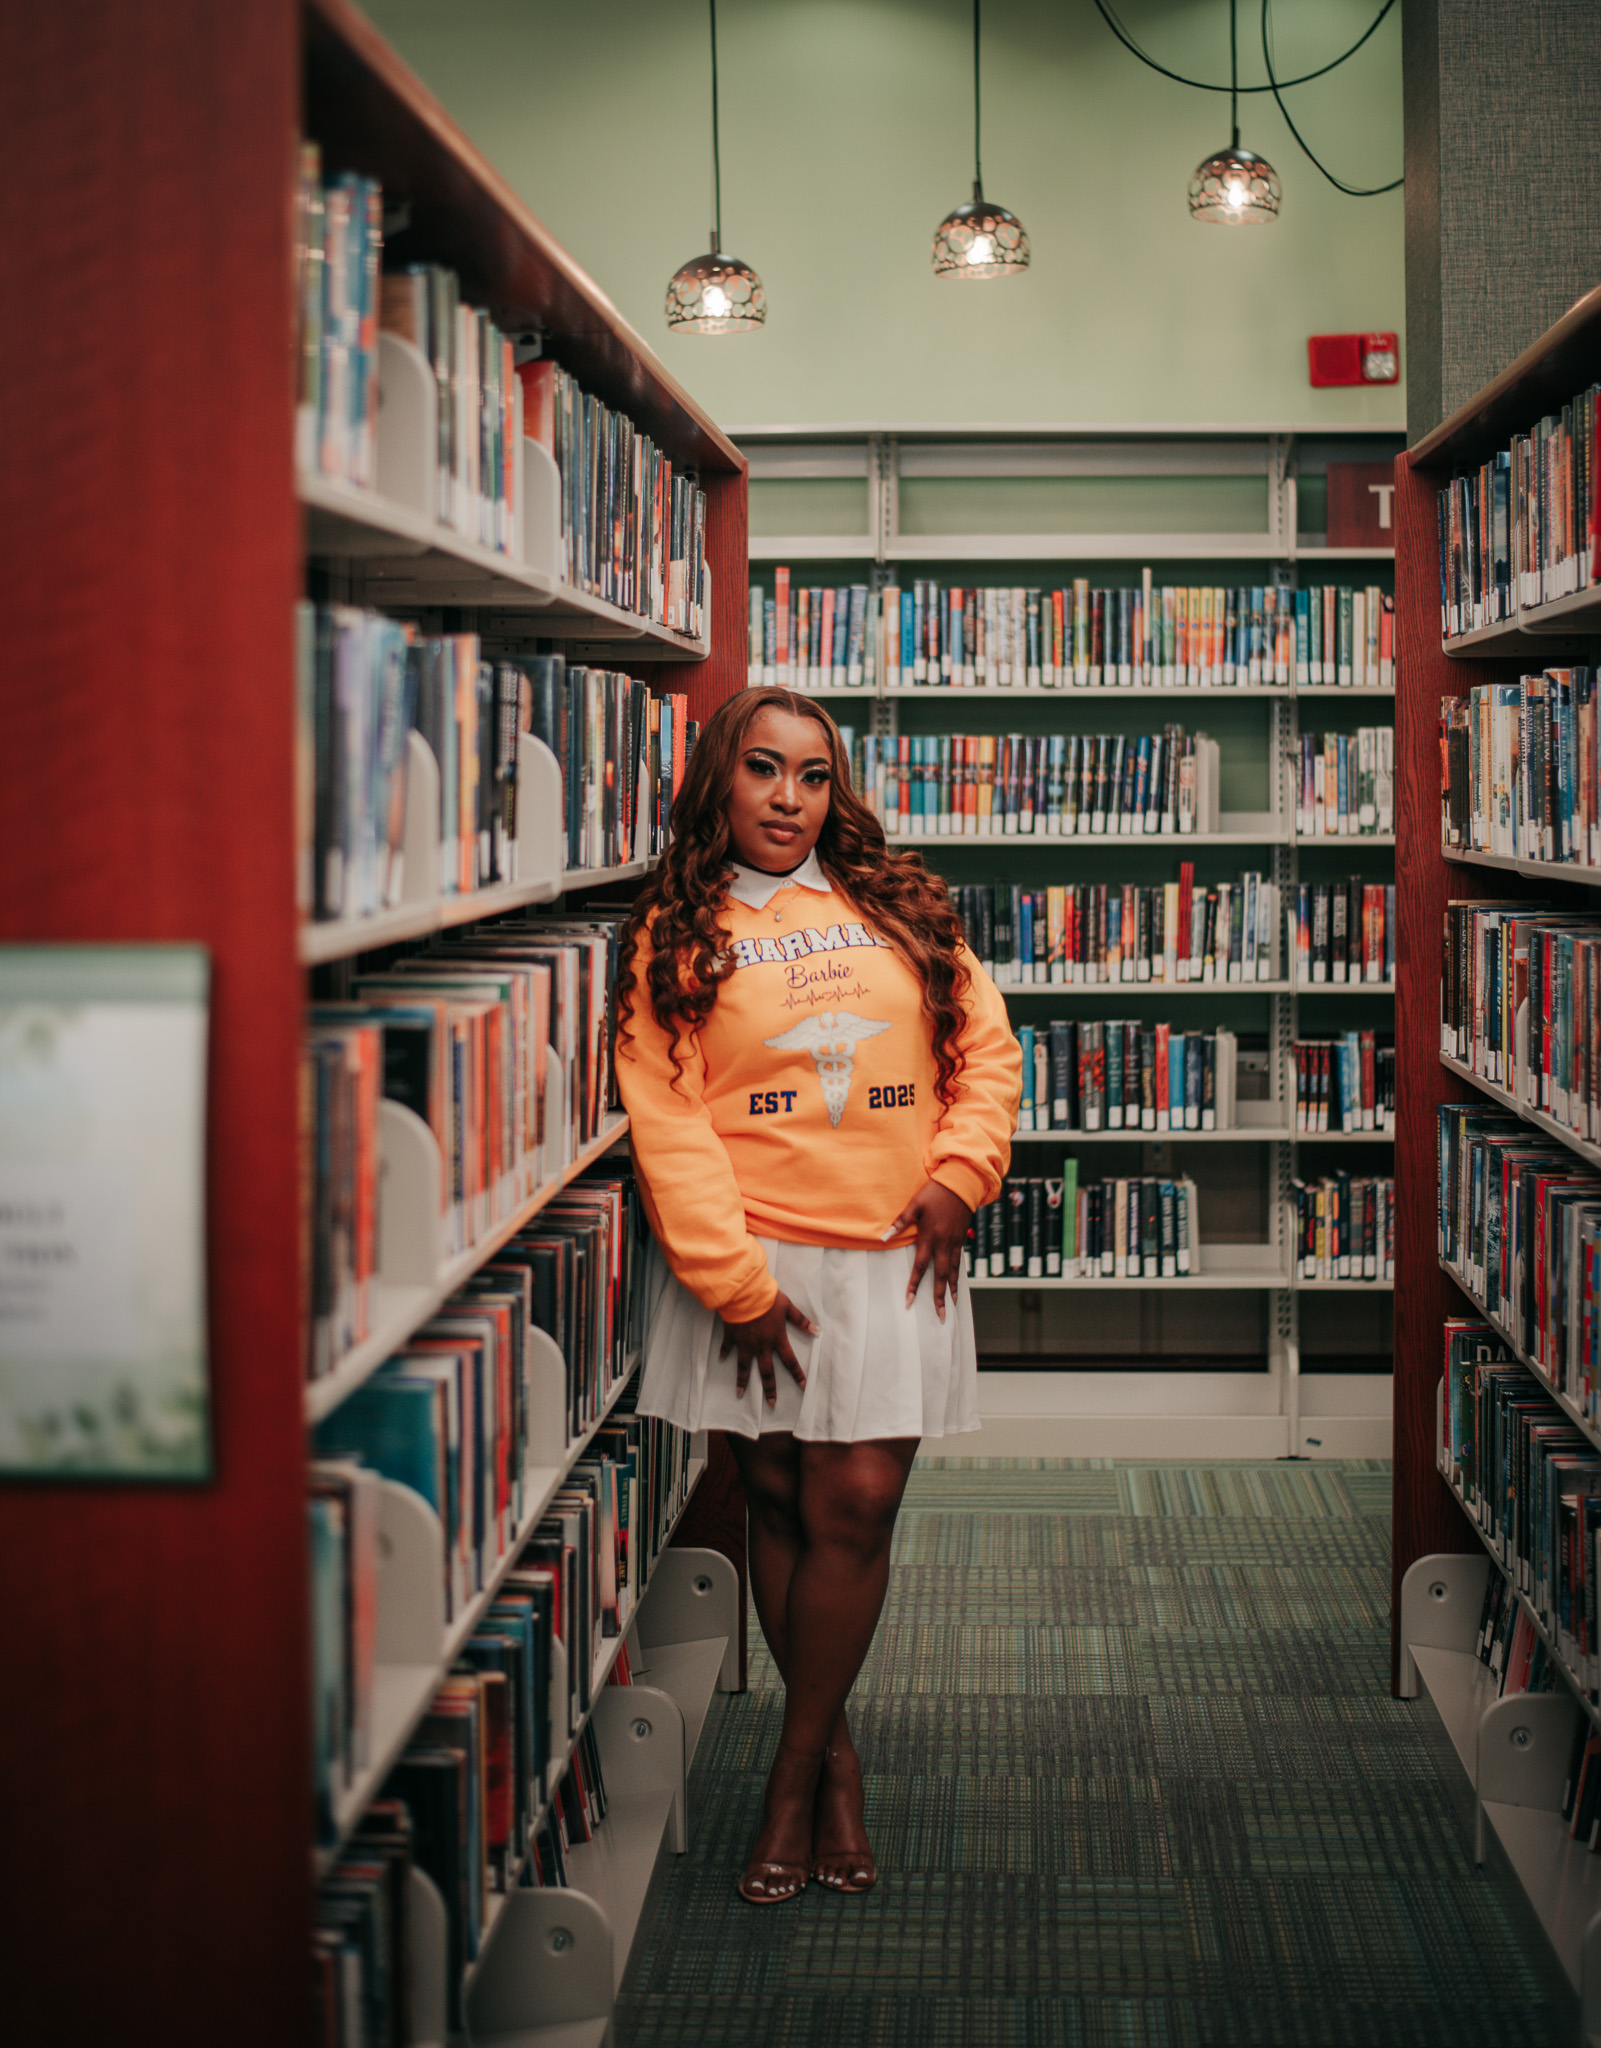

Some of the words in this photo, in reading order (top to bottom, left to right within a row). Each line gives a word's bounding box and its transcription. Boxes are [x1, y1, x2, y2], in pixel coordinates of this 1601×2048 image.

[1368, 484, 1395, 528] T
[710, 923, 894, 973] HARMA
[784, 959, 854, 989] Barbie
[749, 1090, 797, 1115] EST
[621, 1494, 629, 1523] RIVALS
